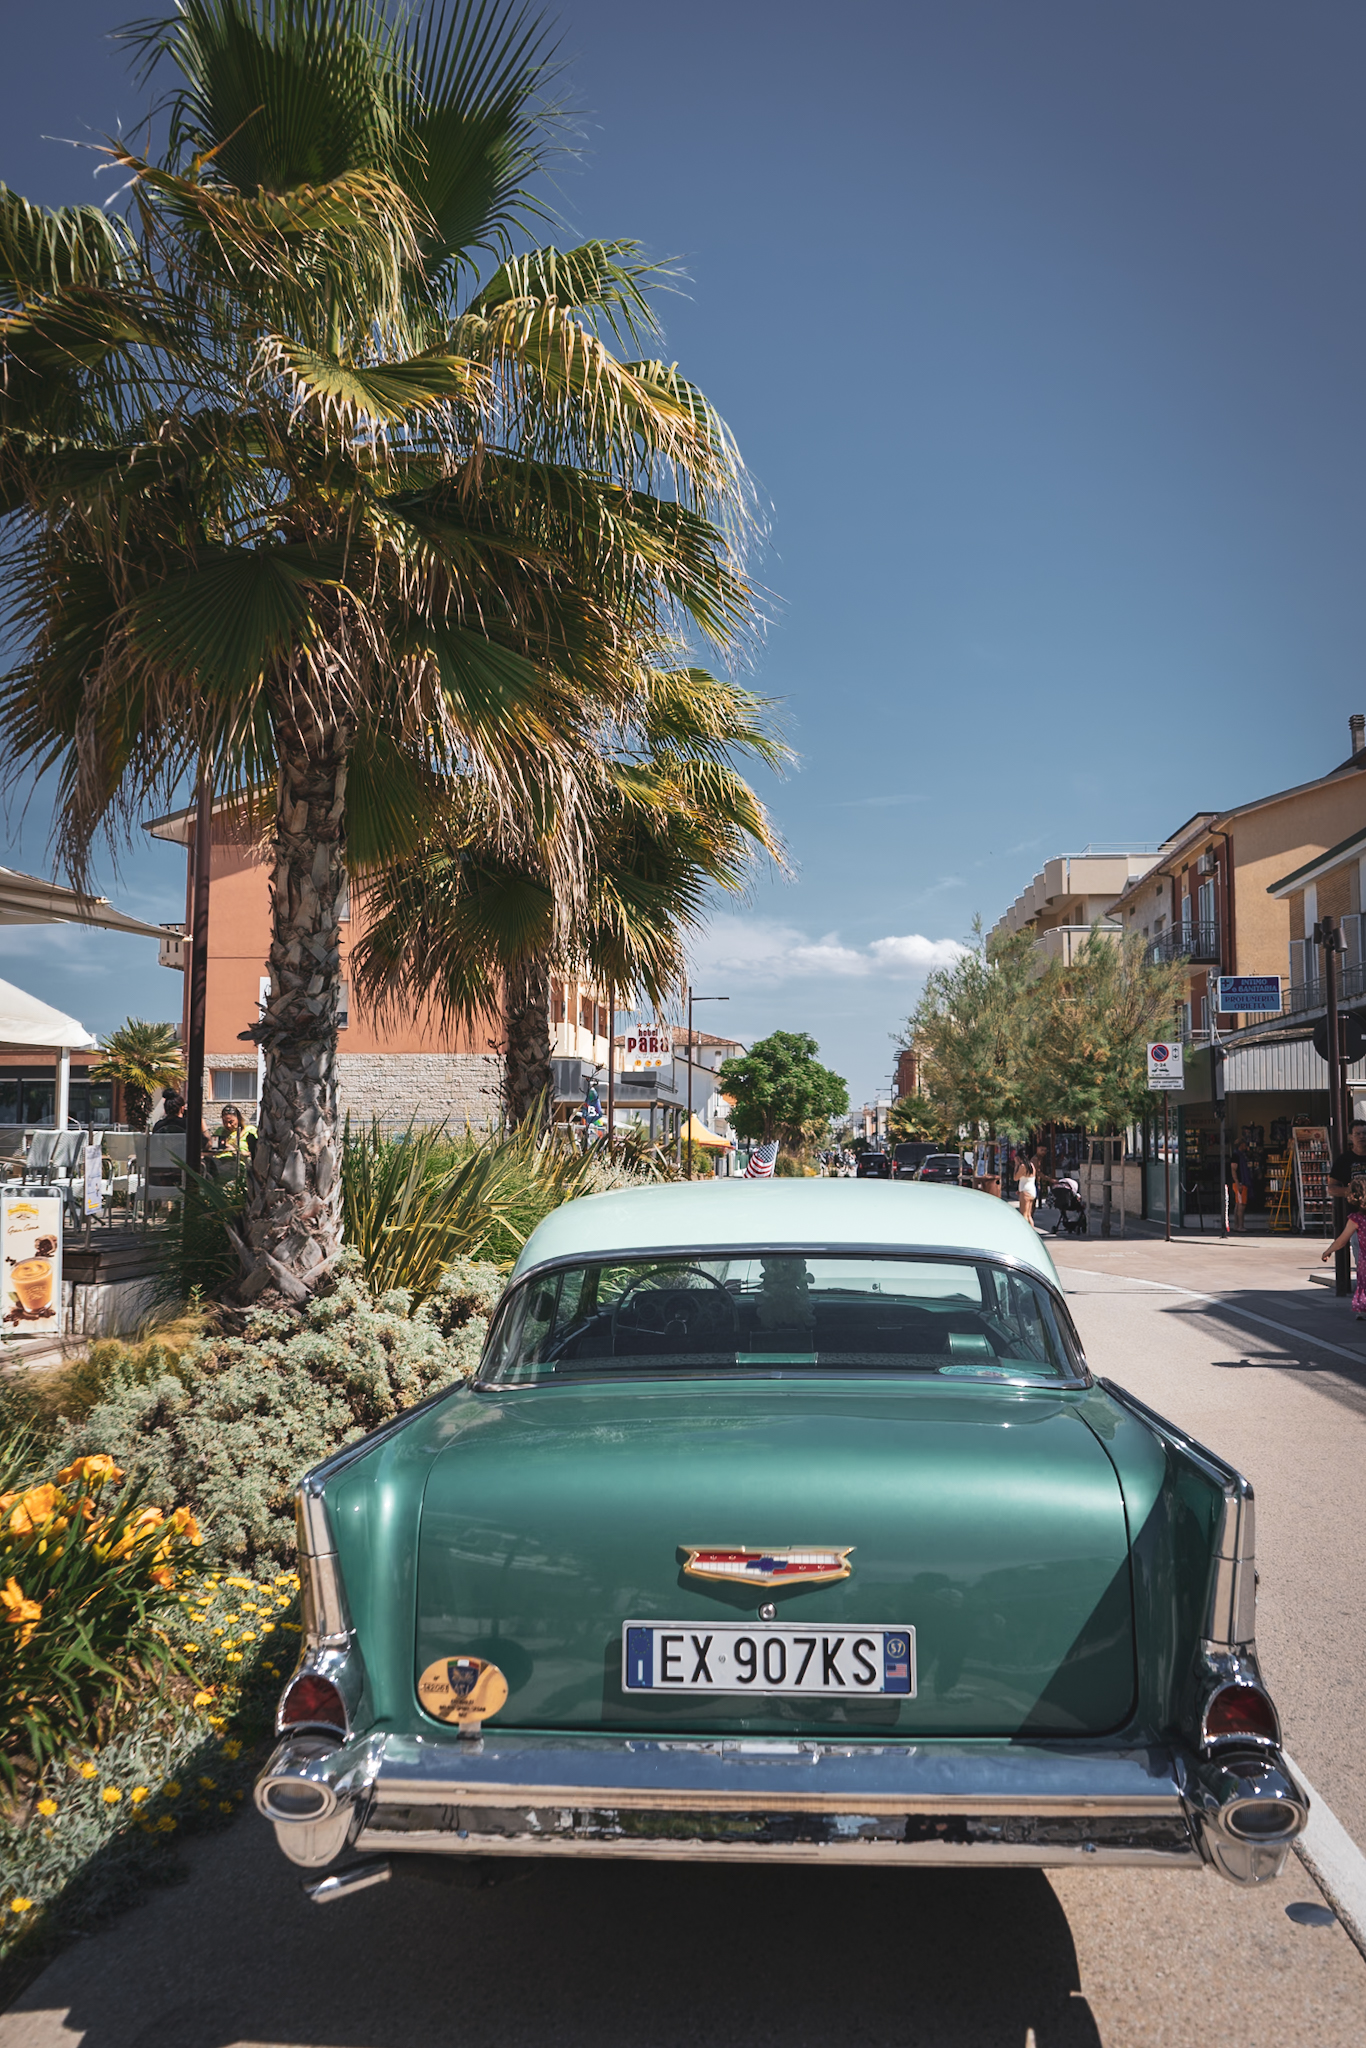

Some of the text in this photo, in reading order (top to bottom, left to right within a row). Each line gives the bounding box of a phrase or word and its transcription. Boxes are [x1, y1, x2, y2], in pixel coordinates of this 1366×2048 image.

[1225, 995, 1275, 1003] PROFUMERIA
[661, 1635, 713, 1683] EX
[734, 1637, 876, 1686] 907KS
